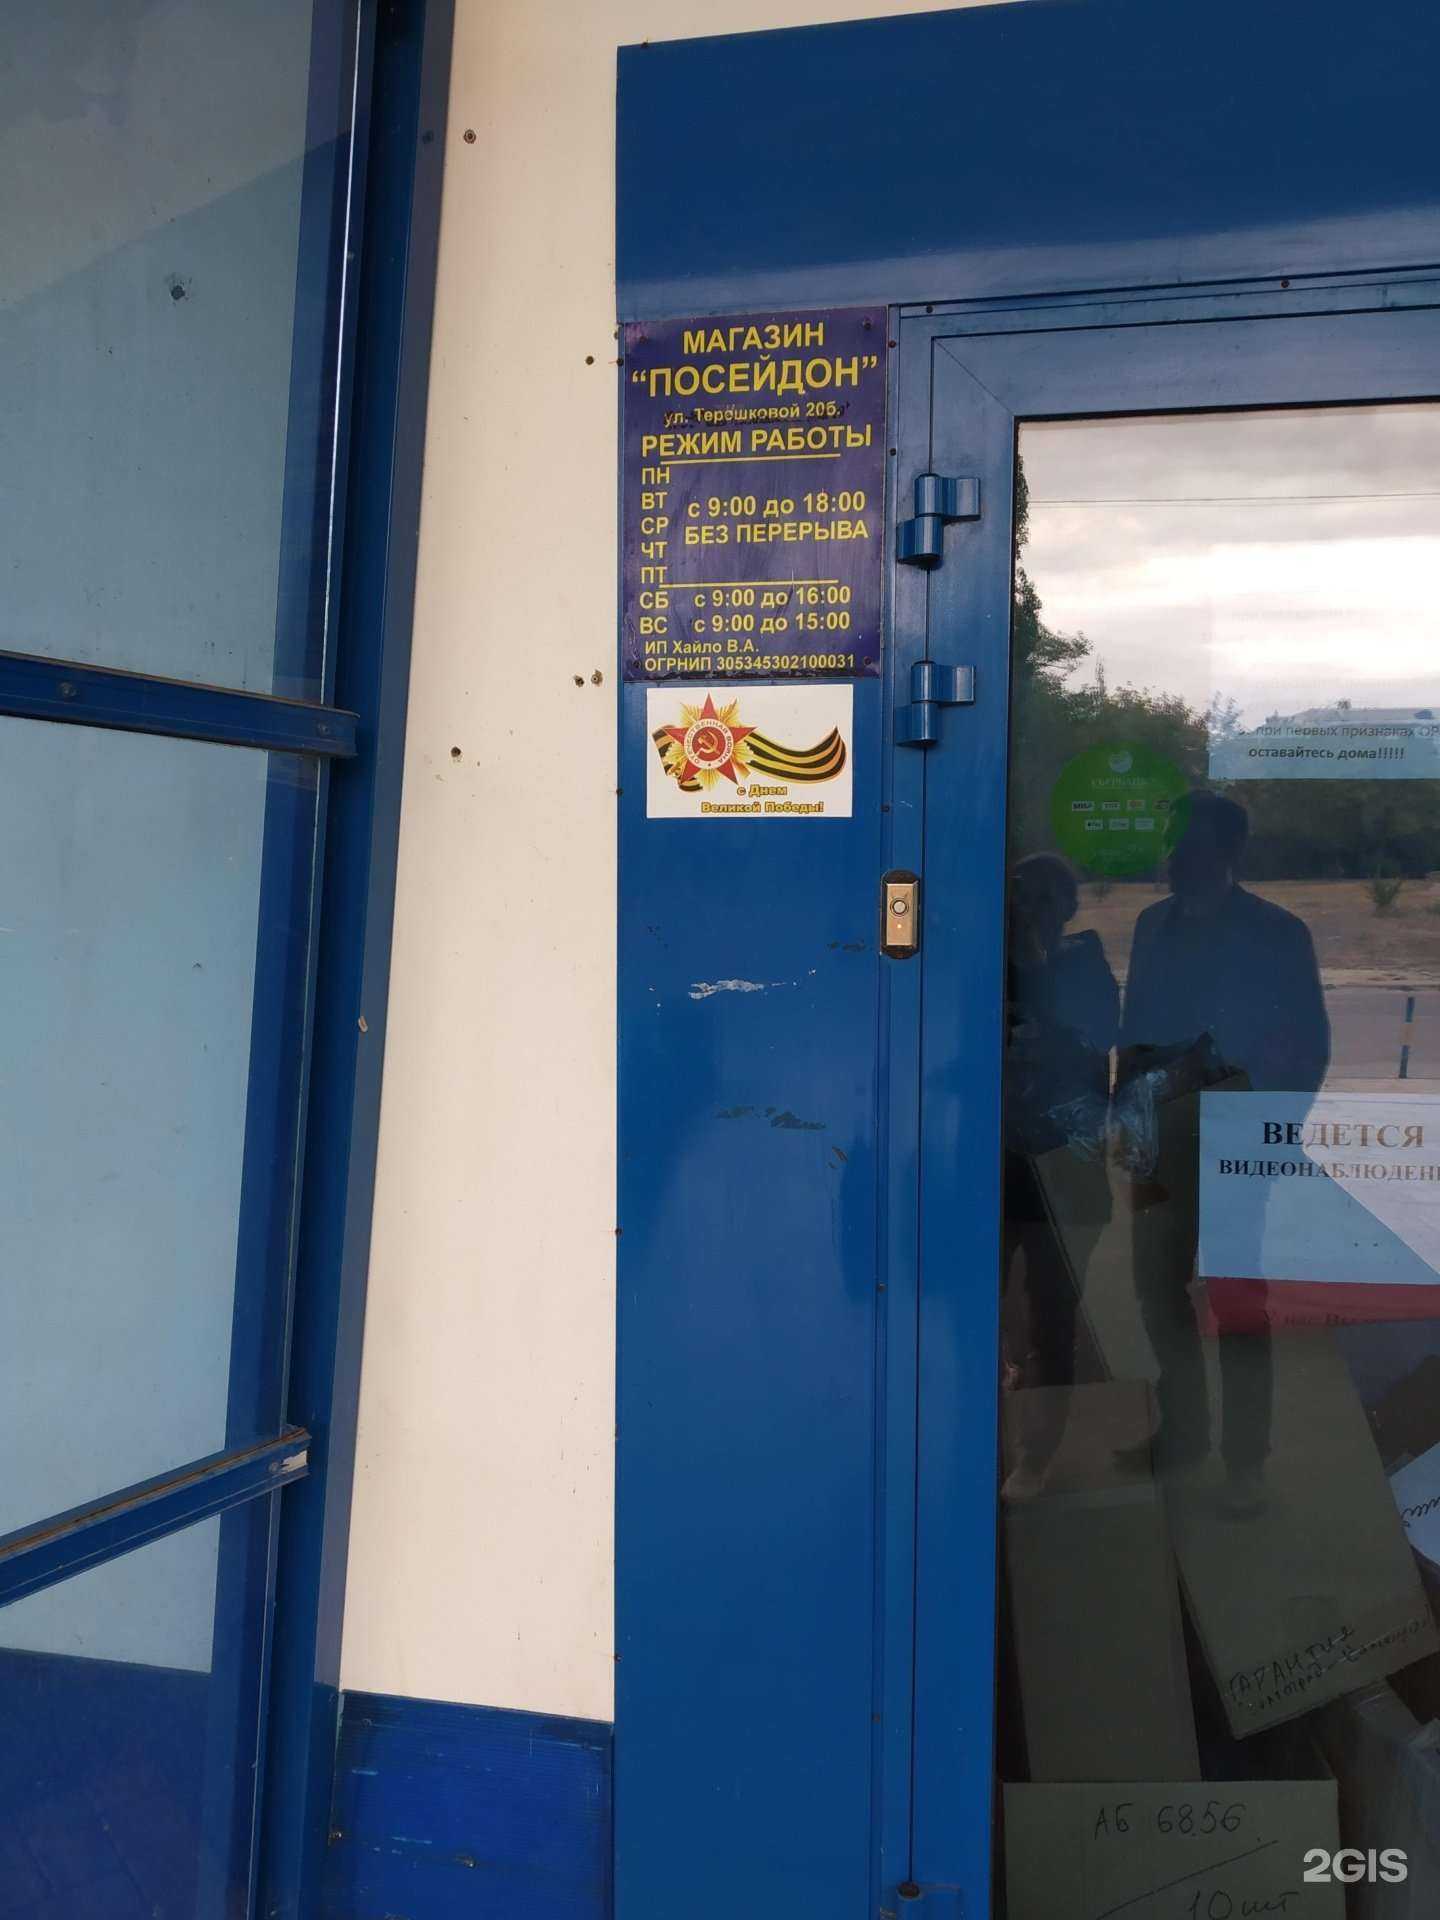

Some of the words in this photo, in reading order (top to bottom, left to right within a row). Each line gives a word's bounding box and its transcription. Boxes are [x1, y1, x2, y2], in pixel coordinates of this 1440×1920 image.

[683, 322, 824, 354] МАГАЗИН
[664, 411, 689, 428] ул.
[641, 431, 742, 458] РЕЖИМ
[751, 424, 873, 451] РАБОТЫ
[641, 466, 671, 485] ПН
[641, 491, 668, 510] ВТ
[687, 502, 701, 518] с
[707, 496, 757, 517] 9:00
[763, 499, 795, 518] до
[802, 491, 866, 514] 18:00
[640, 516, 670, 535] СР
[685, 524, 729, 545] БЕЗ
[736, 519, 869, 543] ПЕРЕРЫВА
[641, 541, 668, 559] ЧТ
[640, 566, 668, 584] ПТ
[639, 591, 669, 610] СБ
[694, 596, 706, 608] с
[712, 589, 755, 607] 9:00
[761, 592, 788, 608] до
[795, 586, 851, 605] 16:00
[639, 616, 668, 635] ВС
[694, 621, 706, 633] с
[711, 614, 754, 632] 9:00
[760, 617, 788, 634] до
[795, 611, 850, 630] 15:00
[645, 640, 667, 654] ИП
[672, 640, 722, 654] Хайло
[727, 638, 760, 653] В.А.
[644, 656, 712, 672] ОГРНИП
[716, 654, 855, 671] 305345302100031
[1256, 725, 1282, 739] при
[1287, 726, 1337, 737] первых
[1342, 726, 1414, 740] признаках
[1248, 747, 1334, 759] оставайтесь
[749, 785, 788, 797] Днем
[701, 801, 761, 813] Великой
[764, 801, 824, 814] Победы!
[1263, 1121, 1425, 1149] ВЕДЕТСЯ
